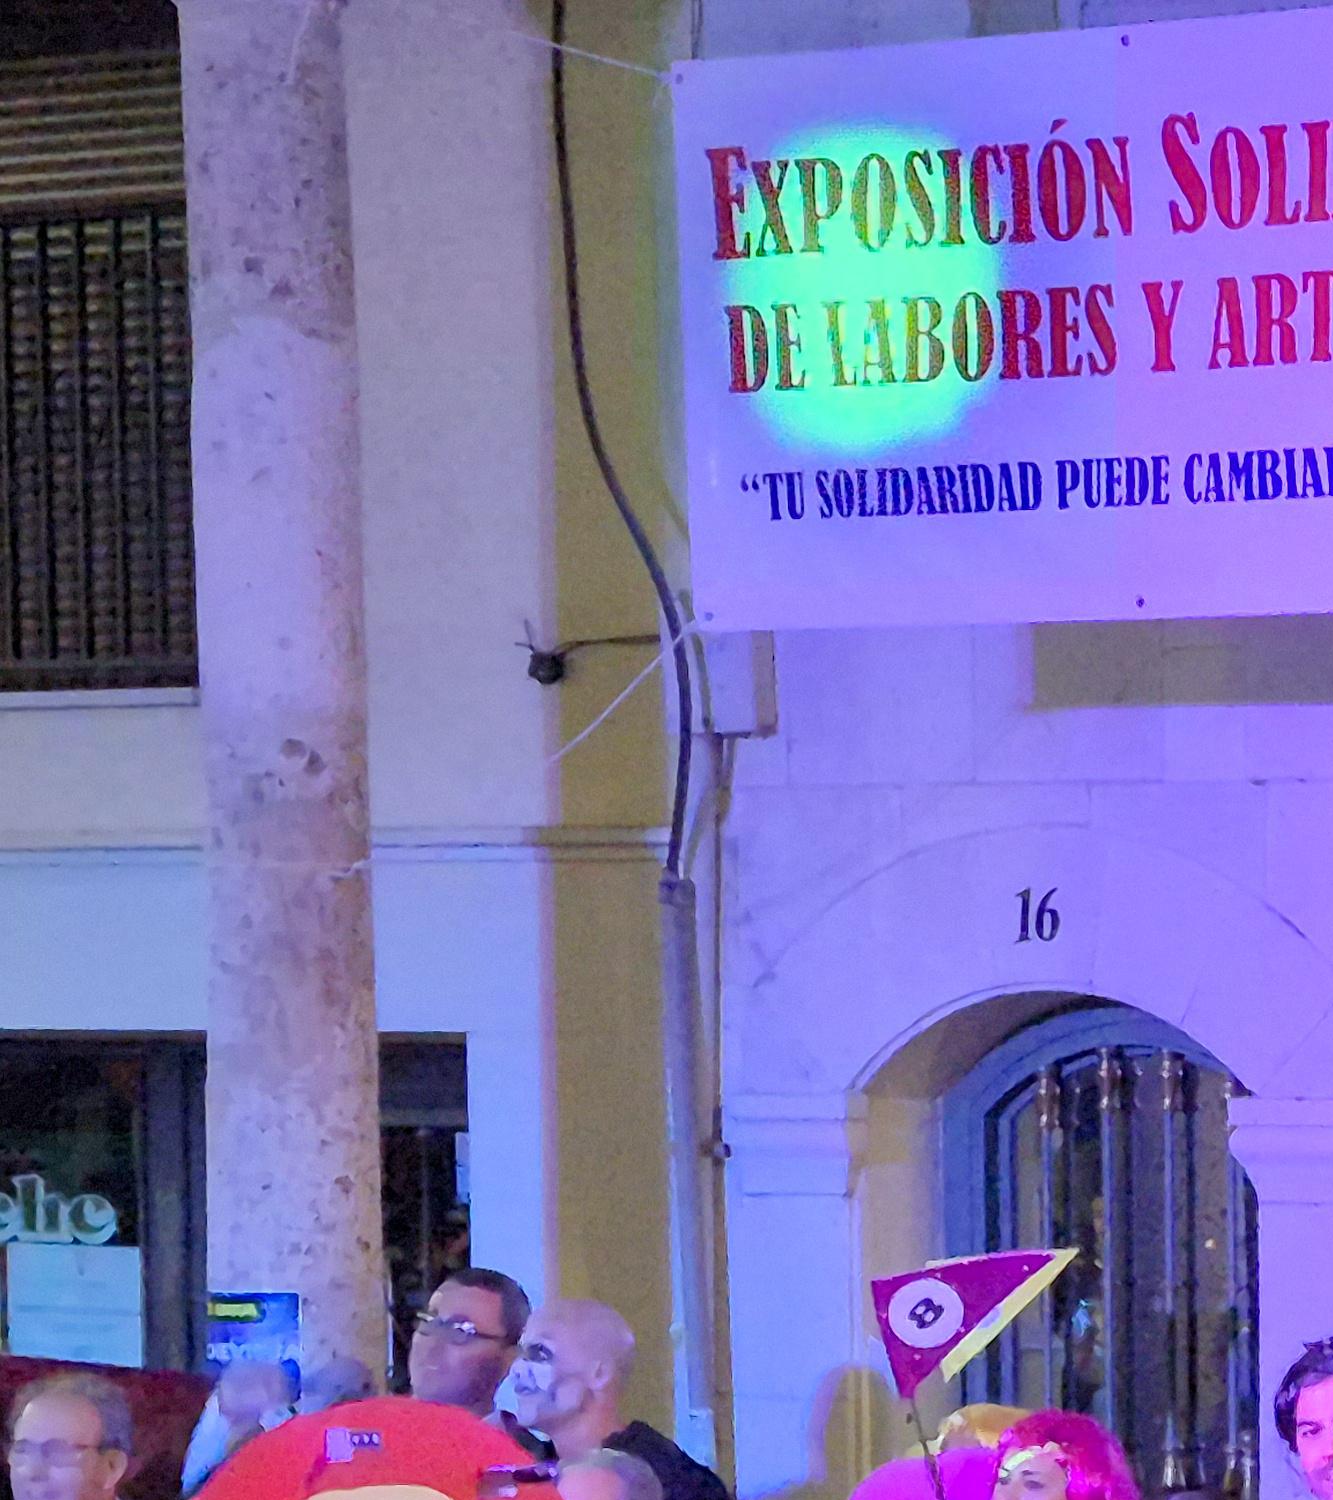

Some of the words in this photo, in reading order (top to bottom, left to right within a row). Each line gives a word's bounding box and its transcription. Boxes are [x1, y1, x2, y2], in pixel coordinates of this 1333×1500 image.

[705, 119, 1133, 261] EXPOSICIÓN
[723, 303, 806, 394] DE
[824, 283, 1118, 387] LABORES
[1142, 279, 1184, 372] Y
[815, 461, 1043, 519] SOLIDARIDAD
[1055, 454, 1170, 511] PUEDE
[1014, 886, 1060, 944] 16
